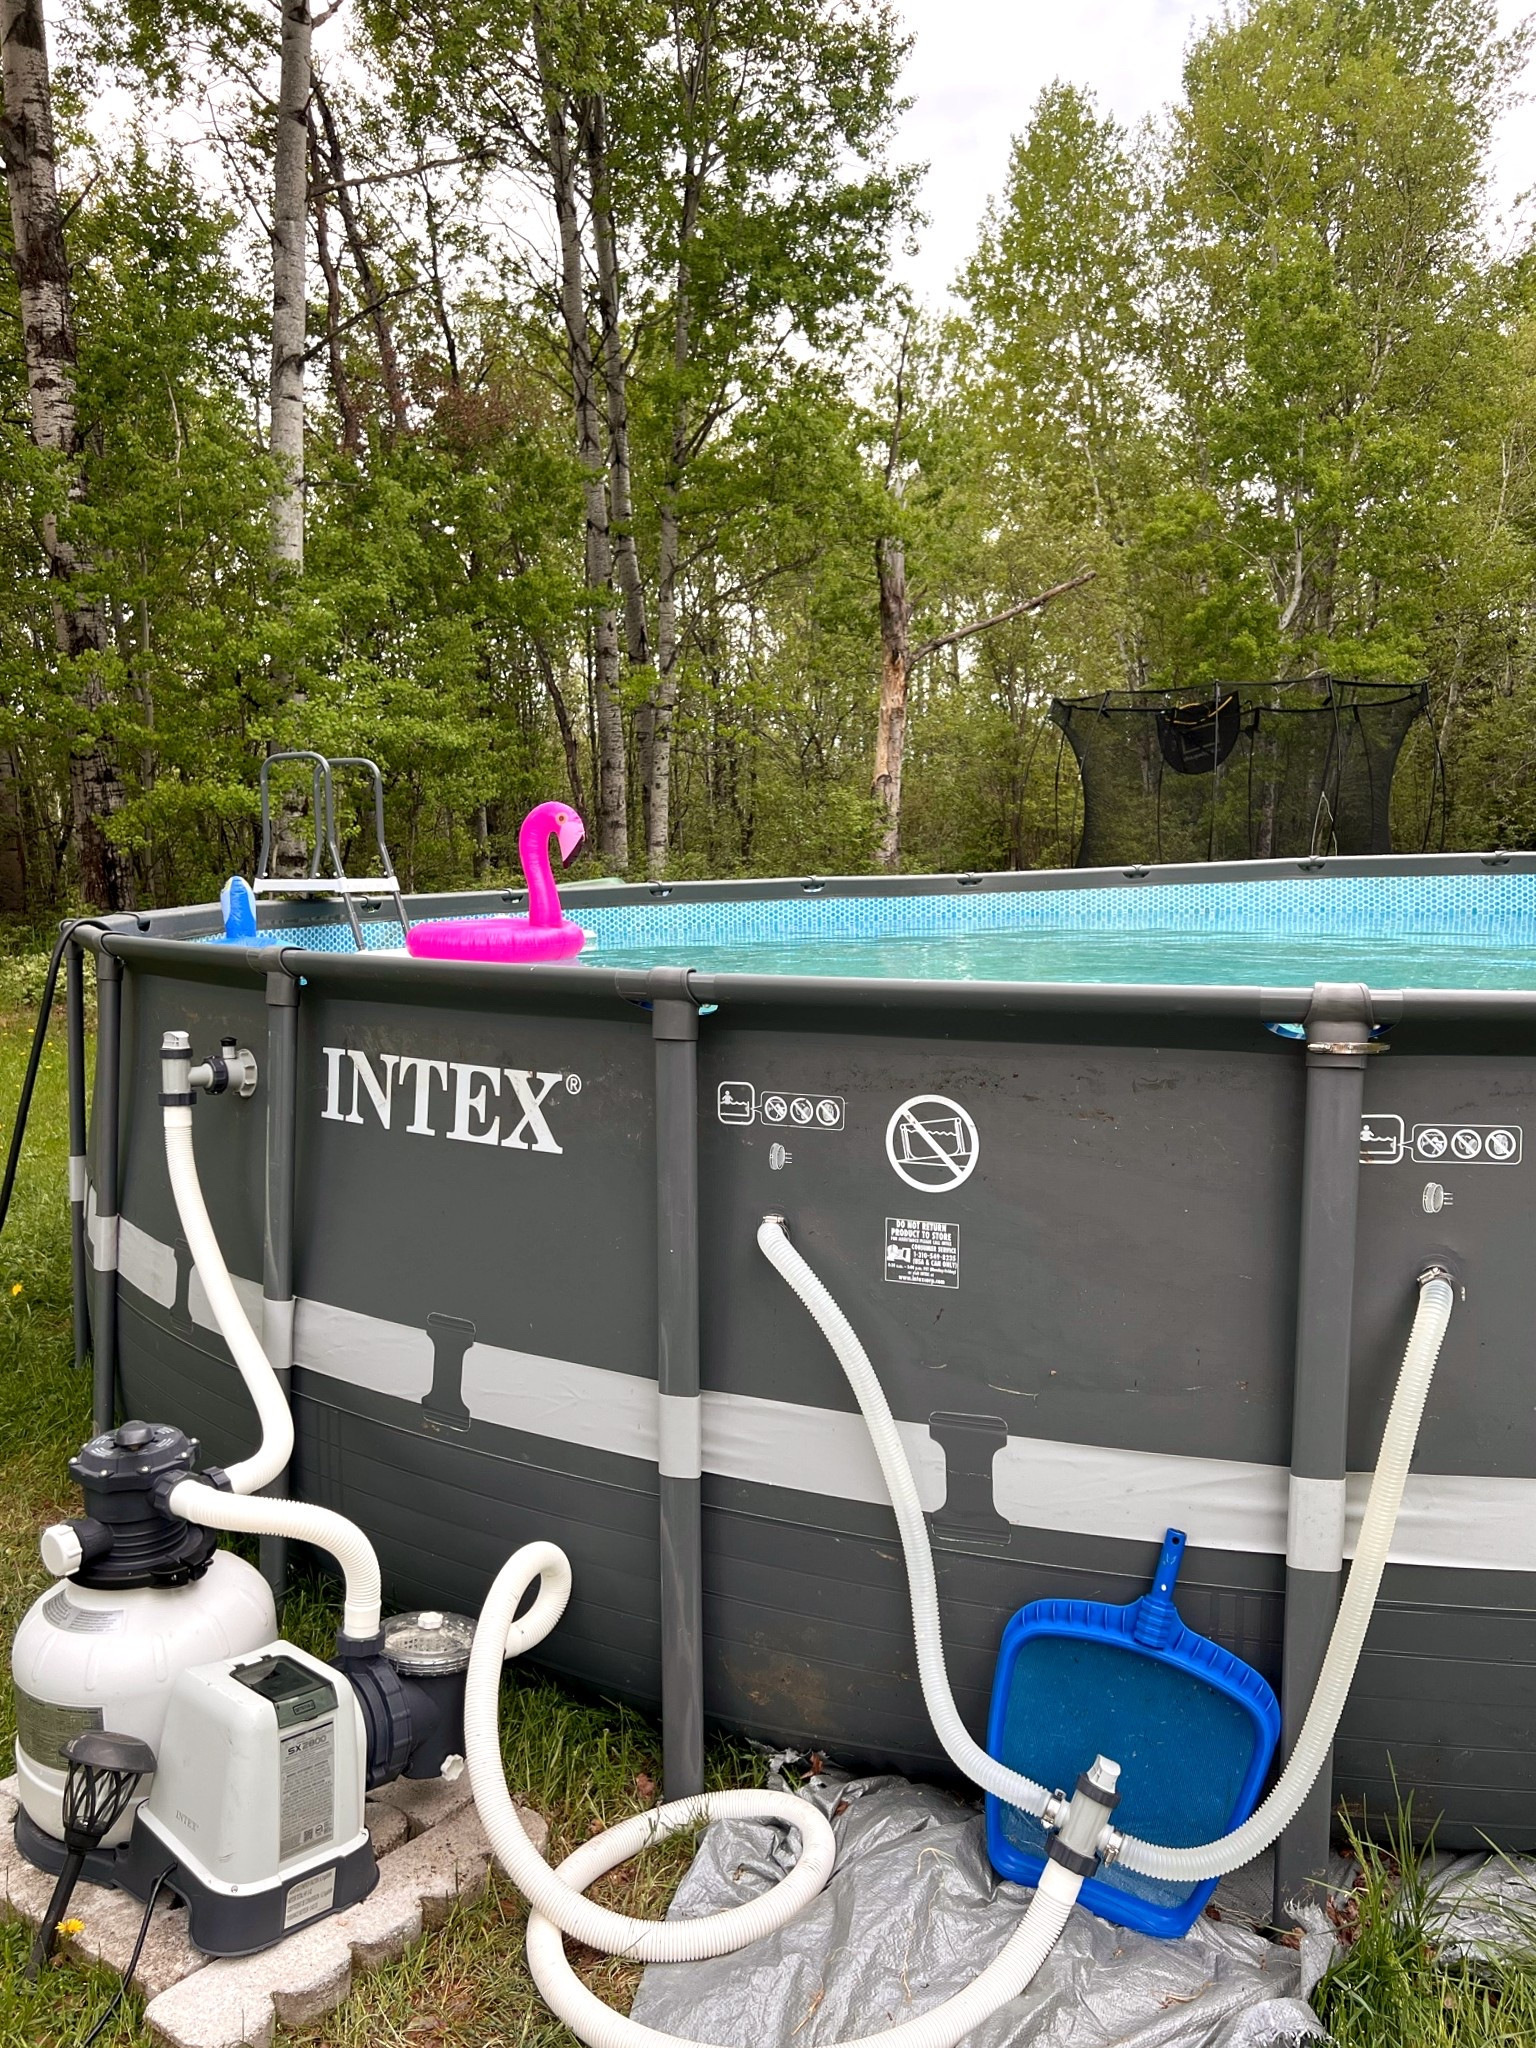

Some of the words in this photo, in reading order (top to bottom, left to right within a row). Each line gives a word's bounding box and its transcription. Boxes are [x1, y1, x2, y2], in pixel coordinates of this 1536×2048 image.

[896, 1220, 906, 1228] DO
[907, 1220, 920, 1230] NOT
[922, 1222, 947, 1232] RETURN
[891, 1228, 920, 1239] PRODUCT
[922, 1231, 930, 1239] TO
[932, 1232, 952, 1241] STORE
[938, 1246, 956, 1254] SERVICE
[288, 1734, 326, 1755] SX2800
